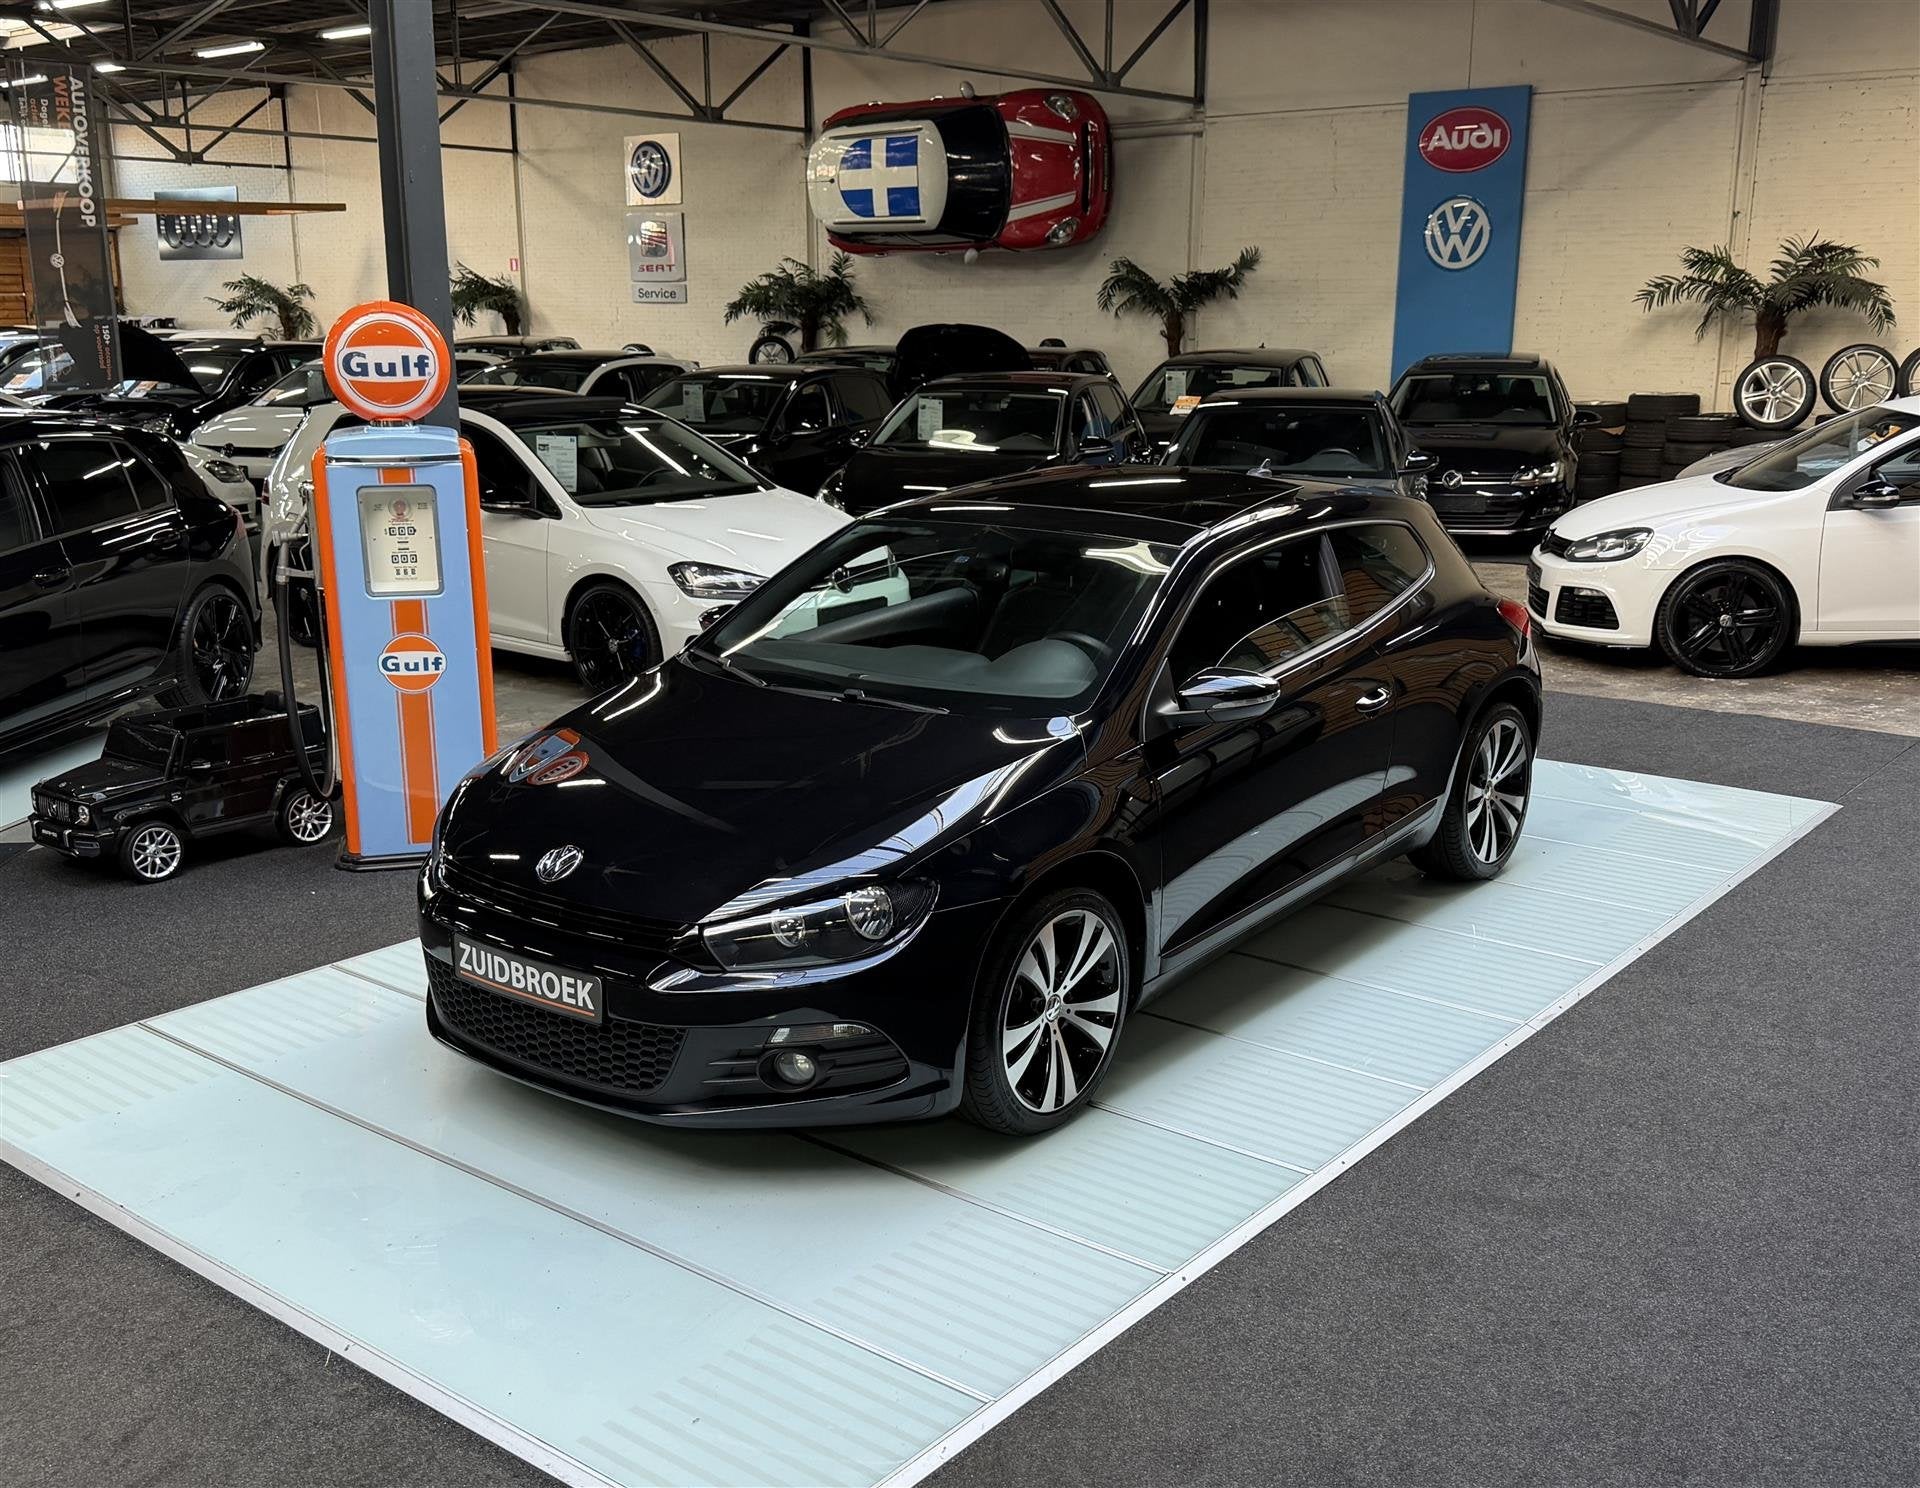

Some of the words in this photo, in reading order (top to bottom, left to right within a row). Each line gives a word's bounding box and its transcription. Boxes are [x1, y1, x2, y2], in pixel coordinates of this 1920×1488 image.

[1427, 123, 1501, 151] Audi
[69, 76, 96, 227] AUTOVERKOOP
[638, 264, 675, 273] SEAT
[638, 287, 677, 299] Service
[102, 325, 111, 345] 150+
[342, 351, 430, 378] Gulf
[381, 655, 443, 673] Gulf
[459, 941, 595, 1010] ZUIDBROEK
